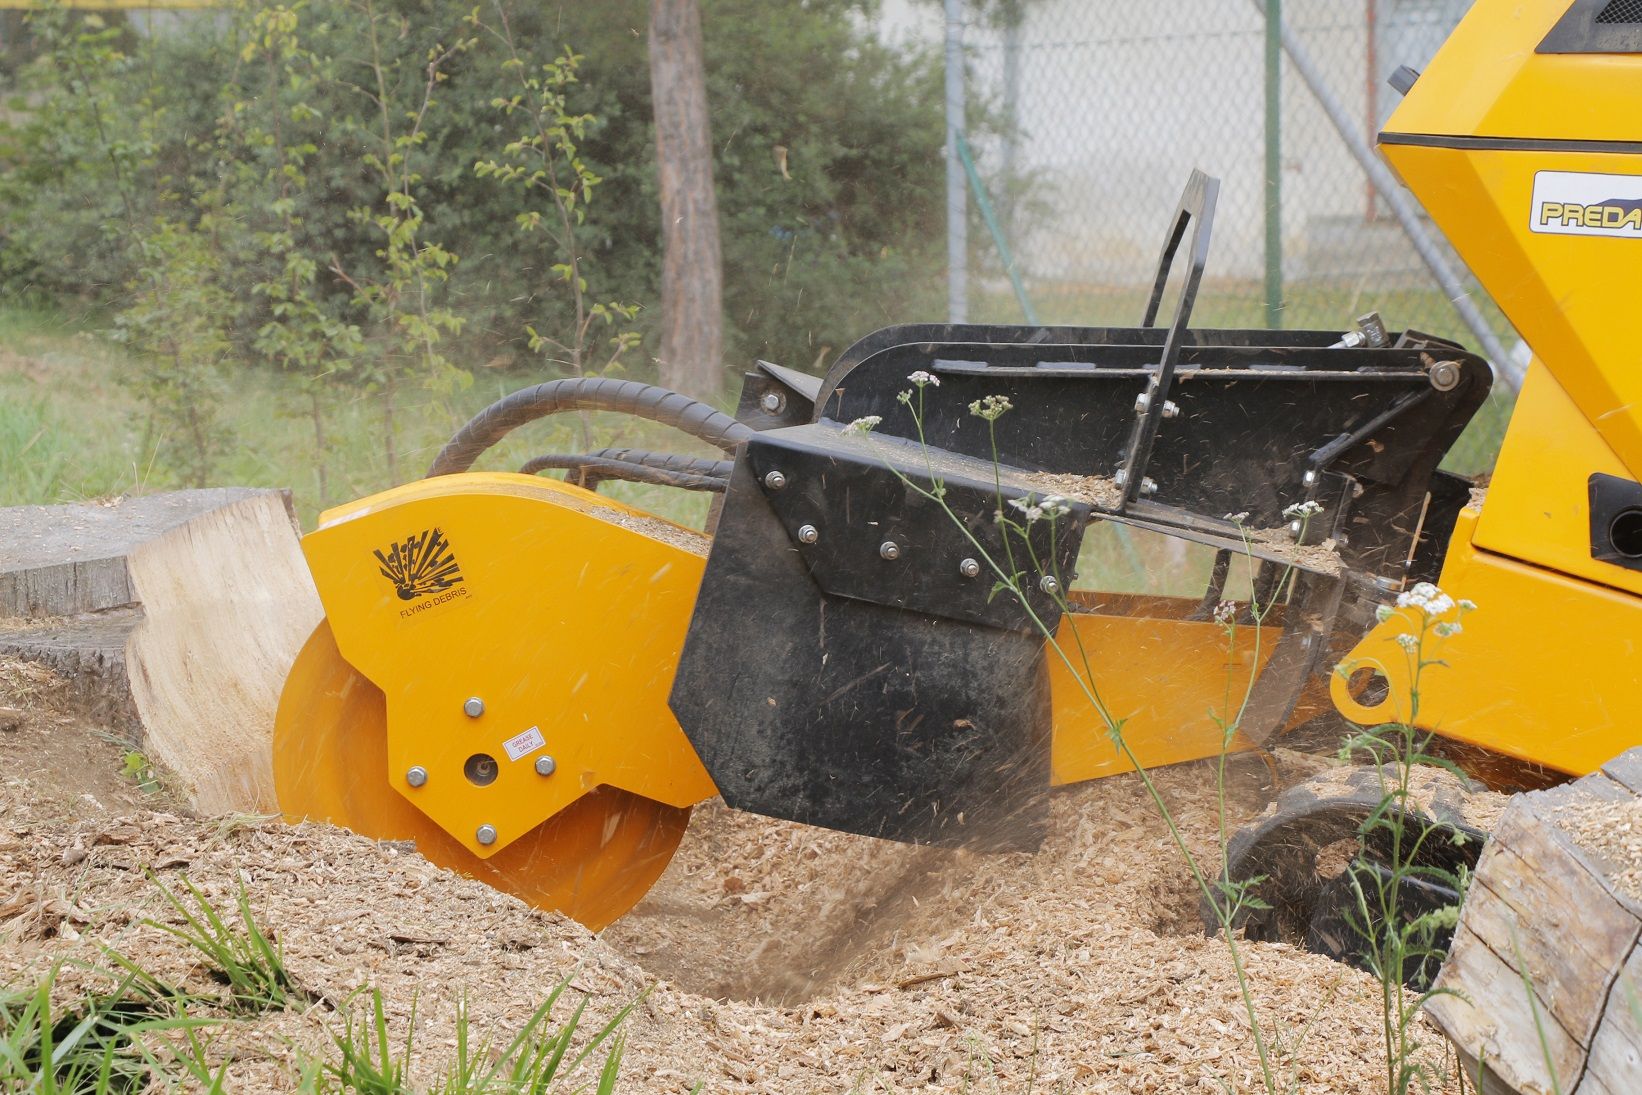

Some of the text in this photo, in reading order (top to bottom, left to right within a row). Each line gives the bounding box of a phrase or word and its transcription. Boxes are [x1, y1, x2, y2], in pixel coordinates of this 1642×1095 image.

[400, 587, 467, 619] FLYING DEBRIS
[512, 733, 534, 748] GREASE
[518, 740, 534, 752] DAILY
